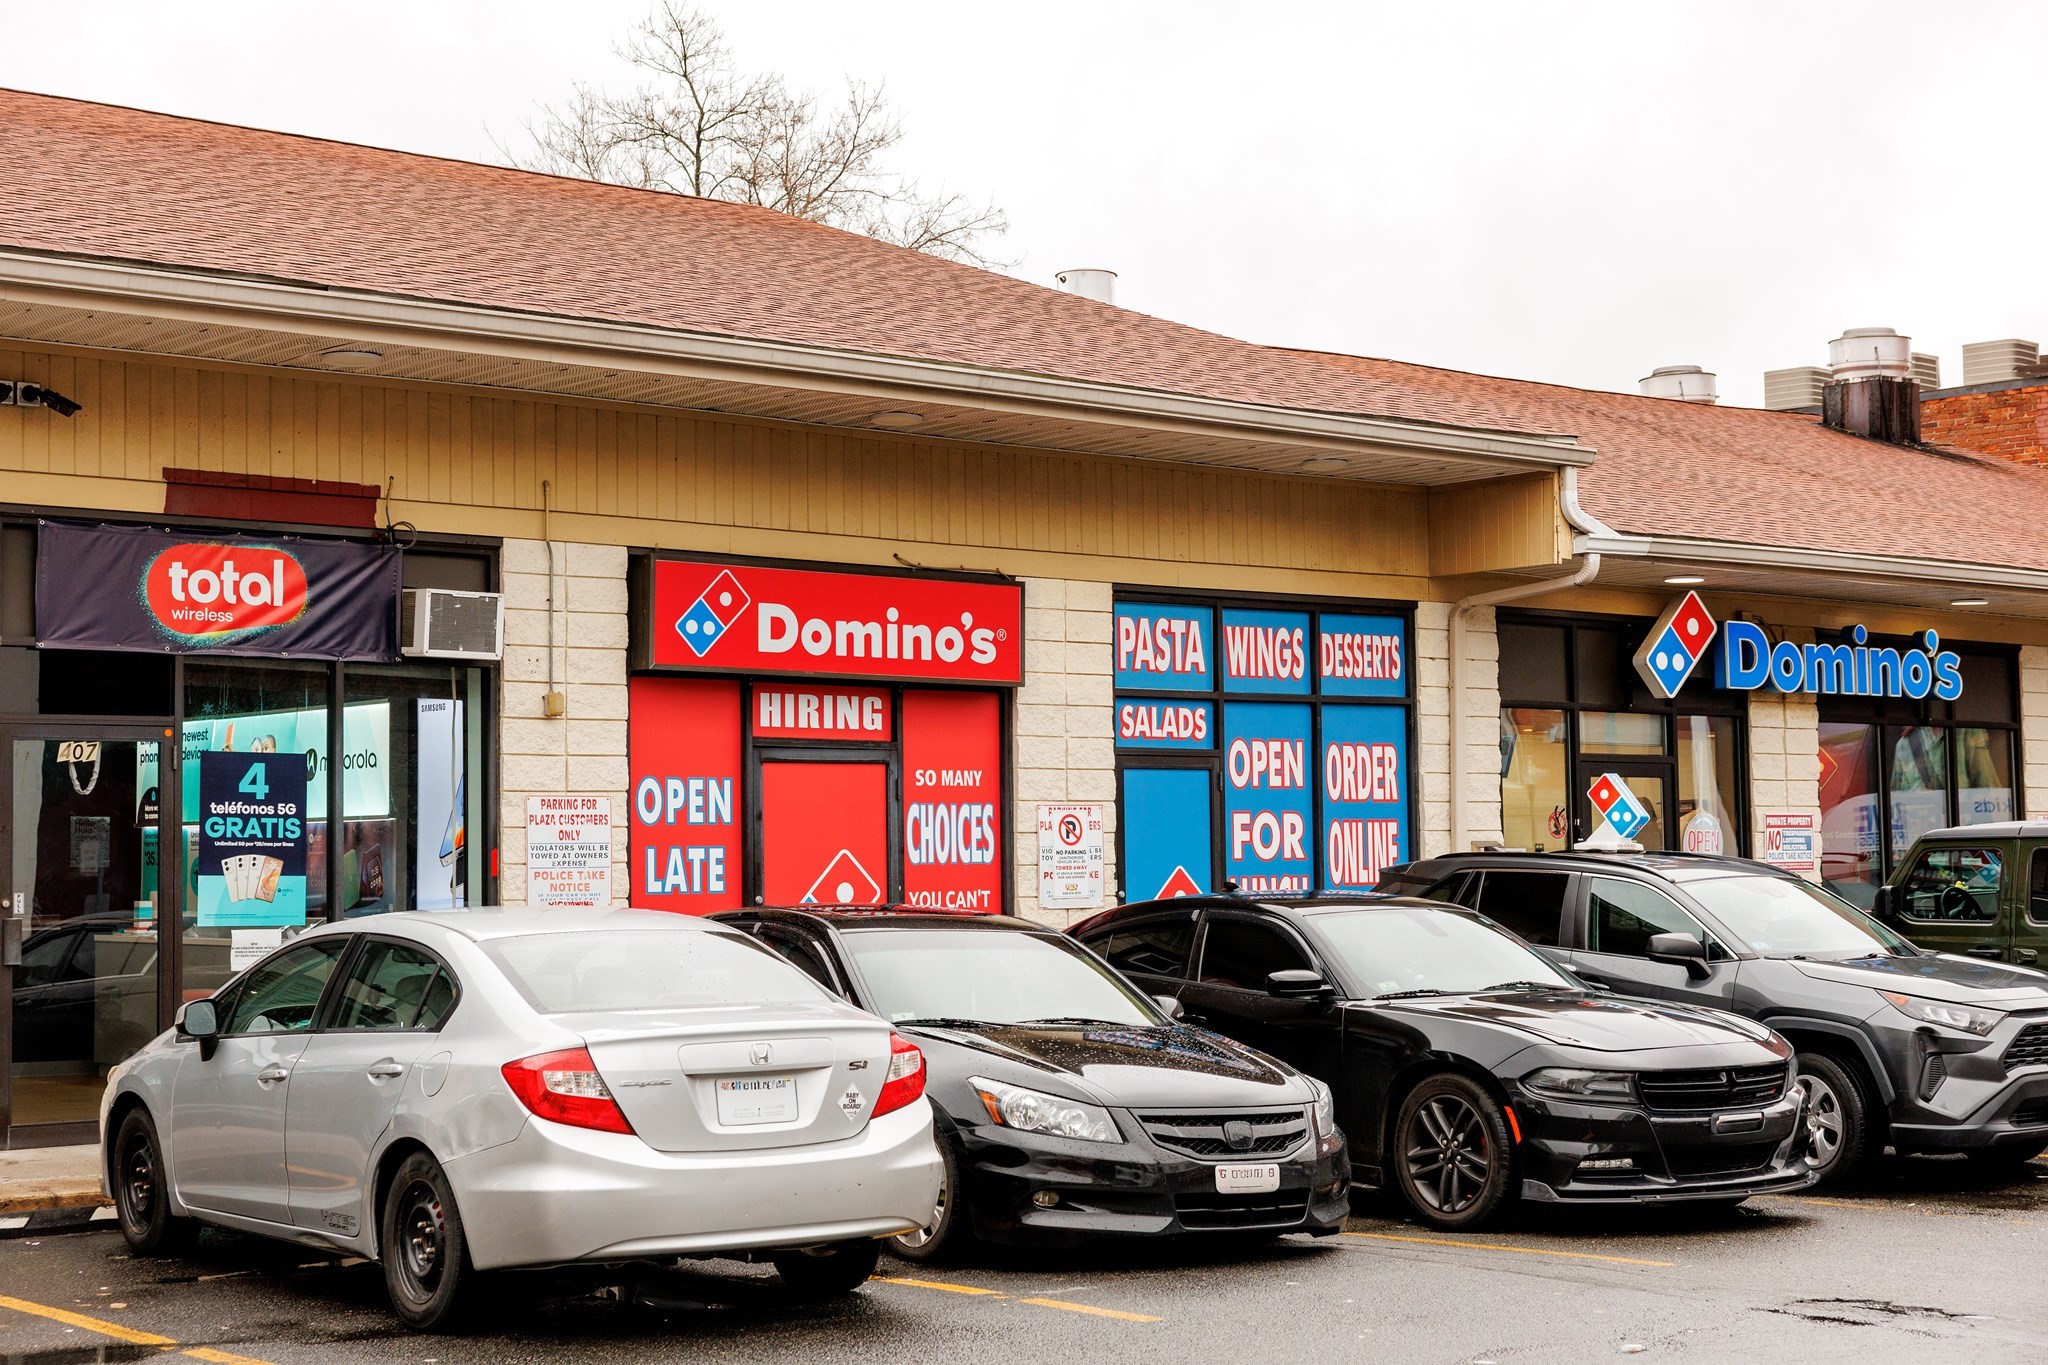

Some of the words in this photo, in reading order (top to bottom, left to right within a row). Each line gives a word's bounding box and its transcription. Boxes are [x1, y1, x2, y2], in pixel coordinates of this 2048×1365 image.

[168, 559, 284, 606] total
[171, 607, 233, 622] wireless
[757, 602, 997, 664] Domino's
[1117, 615, 1206, 674] PASTA
[1224, 625, 1305, 680] WINGS
[1321, 633, 1401, 680] DESSERTS
[1716, 620, 1963, 700] Domino's
[421, 702, 446, 712] SAMSUNG
[759, 692, 884, 731] HIRING
[1120, 705, 1207, 740] SALADS
[182, 728, 208, 742] newest
[60, 742, 98, 760] 407
[140, 750, 158, 766] phon
[182, 746, 202, 760] devic
[1228, 737, 1305, 789] OPEN
[1326, 741, 1400, 803] ORDER
[238, 762, 269, 800] 4
[915, 769, 937, 787] SO
[941, 770, 982, 787] MANY
[210, 801, 274, 814] teléfonos
[276, 803, 296, 815] 5G
[540, 798, 578, 810] PARKING
[582, 798, 597, 810] FOR
[635, 775, 733, 826] OPEN
[204, 816, 301, 838] GRATIS
[529, 814, 556, 826] PLAZA
[559, 814, 608, 826] CUSTOMERS
[1040, 820, 1052, 830] PLA
[1766, 816, 1787, 826] PRIVATE
[1787, 816, 1811, 826] PROPERTY
[558, 830, 580, 841] ONLY
[907, 802, 995, 865] CHOICES
[1231, 810, 1307, 861] FOR
[1688, 830, 1719, 852] OPEN
[1768, 830, 1781, 850] NO
[534, 871, 573, 880] POLICE
[577, 871, 604, 879] TAKE
[645, 845, 726, 895] LATE
[550, 883, 590, 892] NOTICE
[908, 890, 942, 907] YOU
[946, 890, 991, 908] CAN'T
